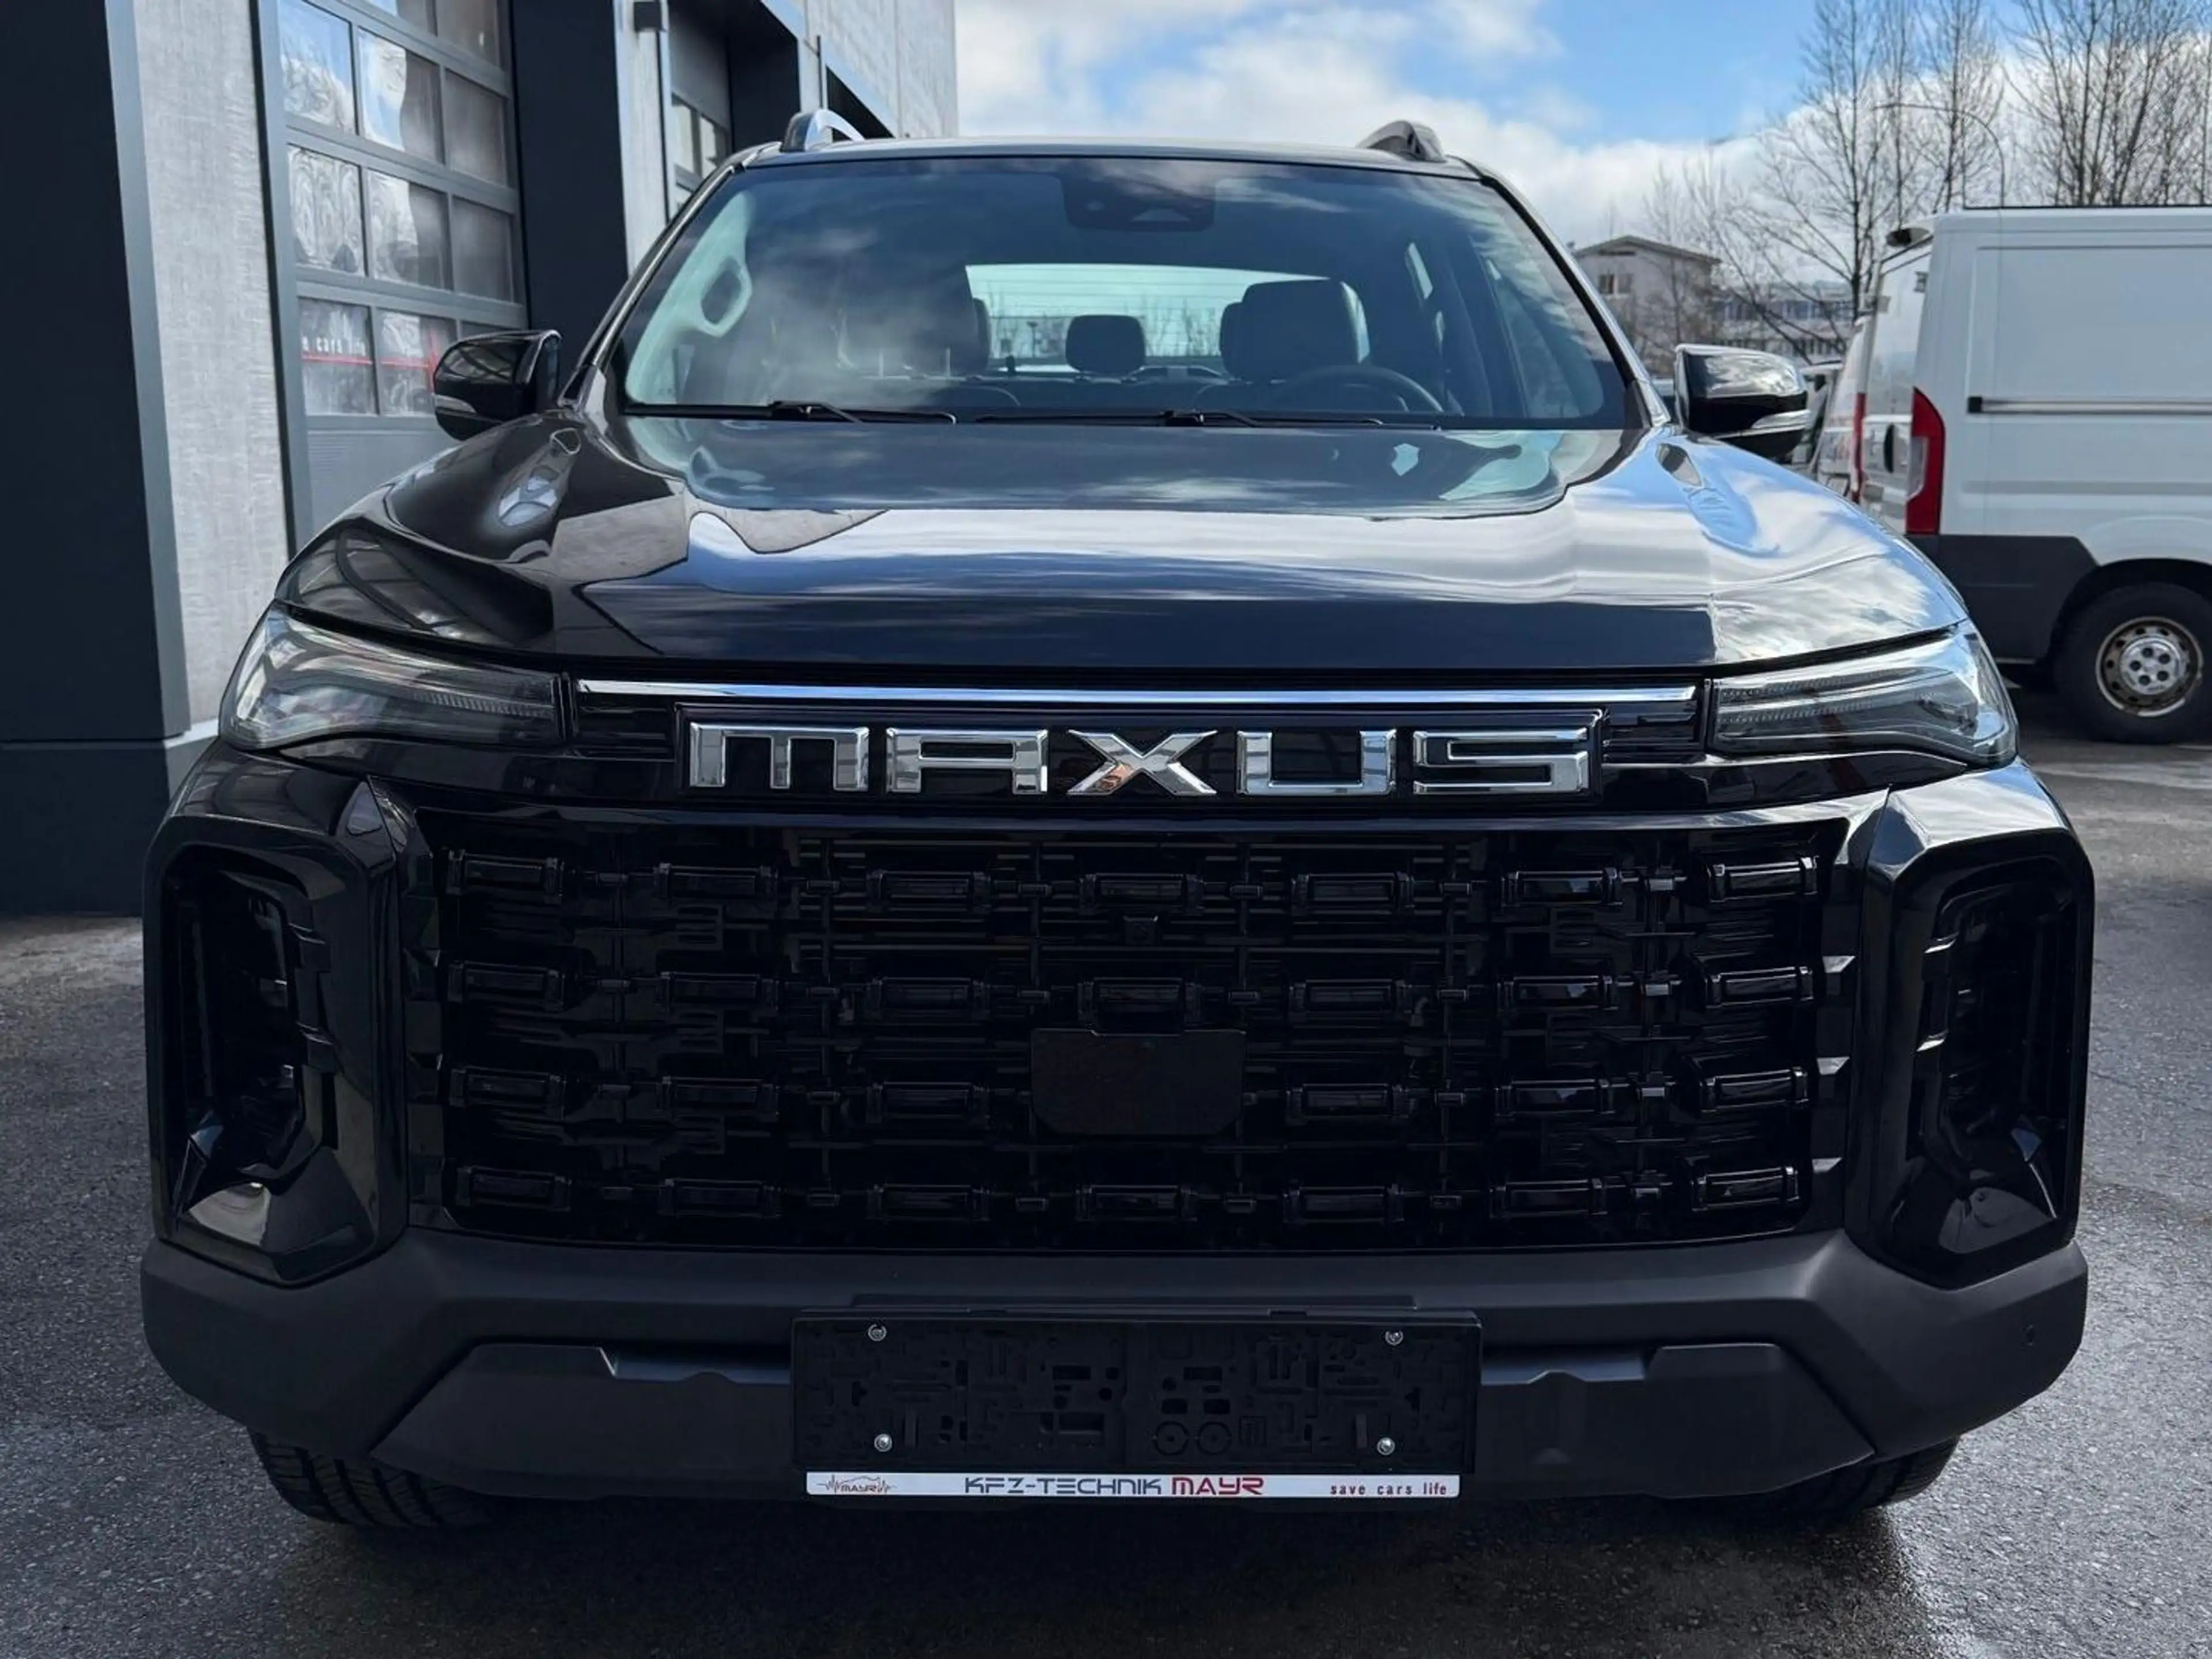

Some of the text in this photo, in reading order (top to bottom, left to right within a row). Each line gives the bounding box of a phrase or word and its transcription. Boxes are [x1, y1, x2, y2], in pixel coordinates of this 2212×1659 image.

[689, 722, 1591, 796] MAXUS
[965, 1476, 1265, 1496] KFZ-TECHNIK MAYR
[1330, 1482, 1447, 1495] save cars life
